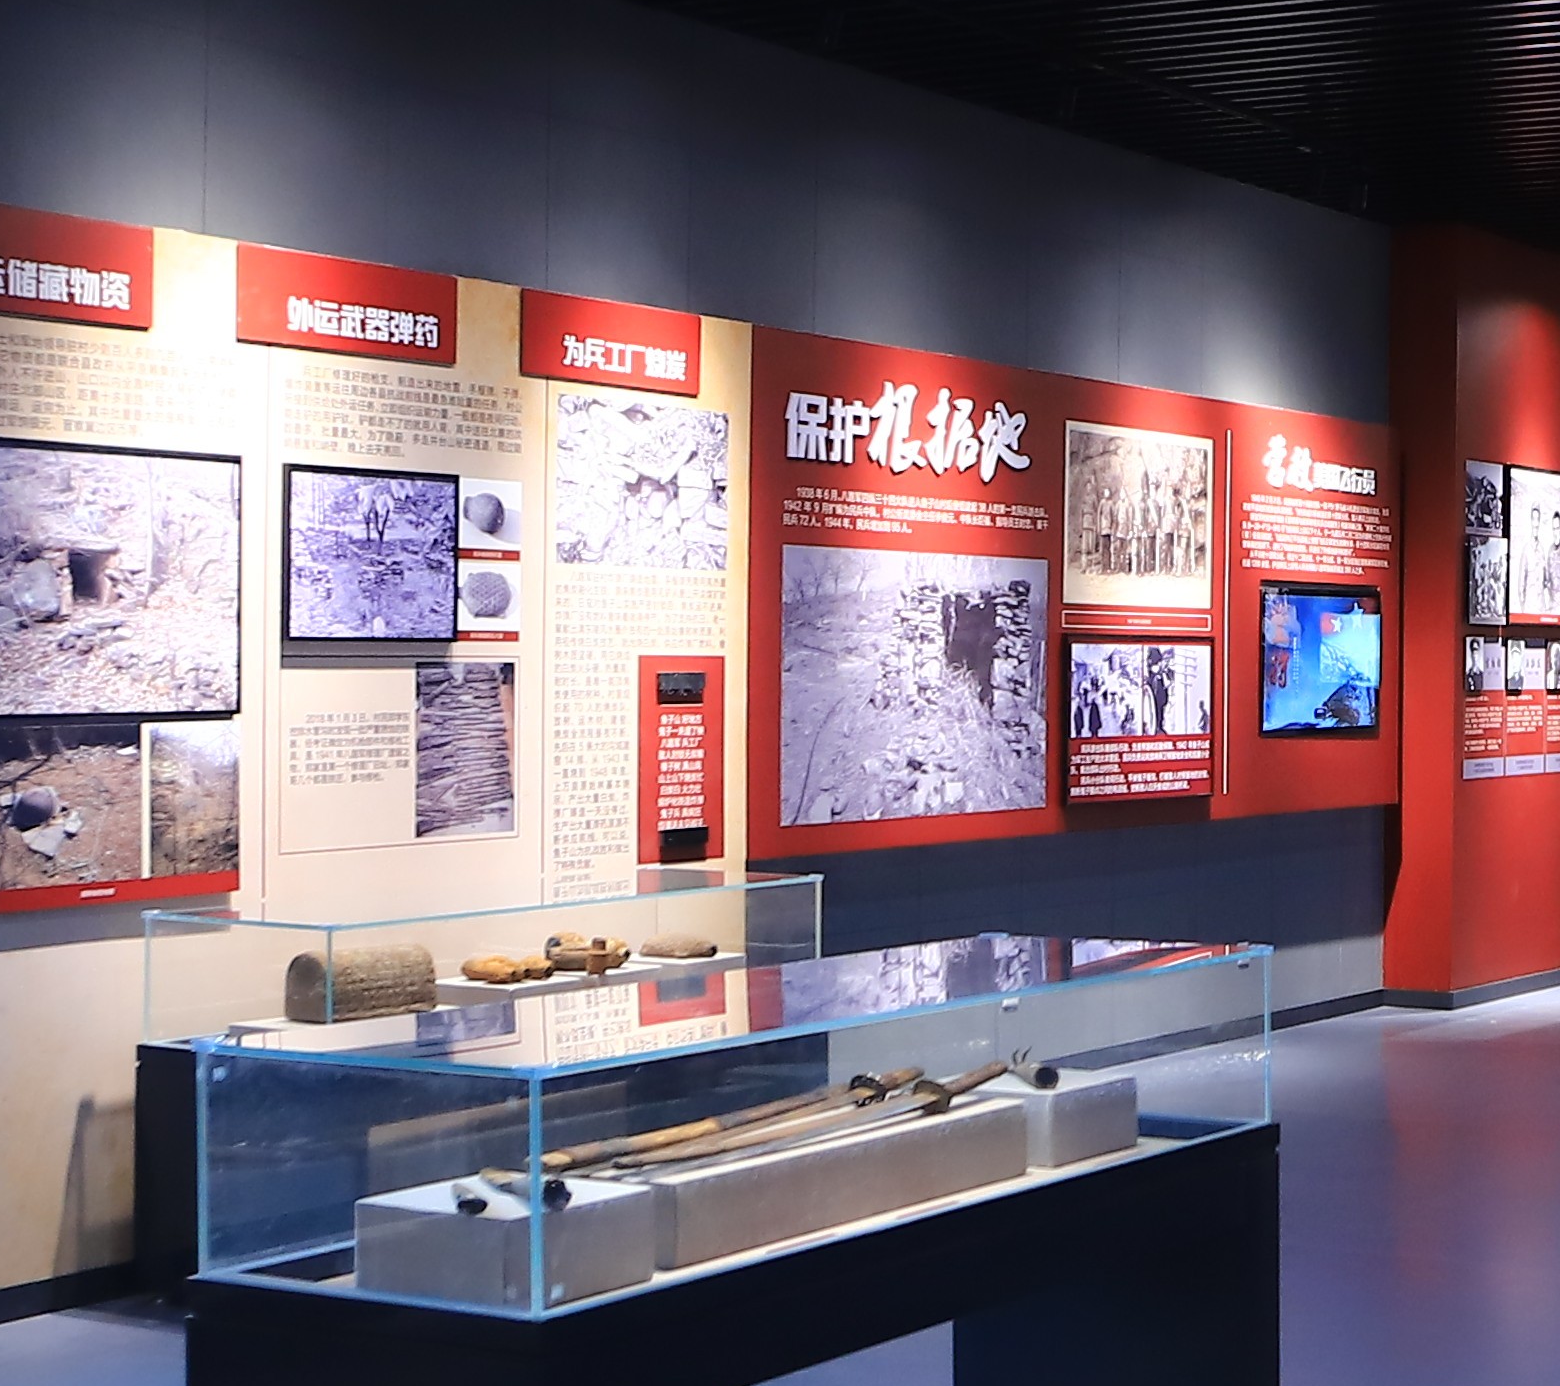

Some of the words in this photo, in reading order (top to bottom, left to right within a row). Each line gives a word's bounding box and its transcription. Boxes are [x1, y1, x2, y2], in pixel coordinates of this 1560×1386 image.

[287, 297, 439, 349] 外运武器弹药
[562, 335, 687, 382] 为兵工厂烧炭
[784, 381, 1031, 483] 保护根据地
[1262, 434, 1376, 495] 营救美国飞行员
